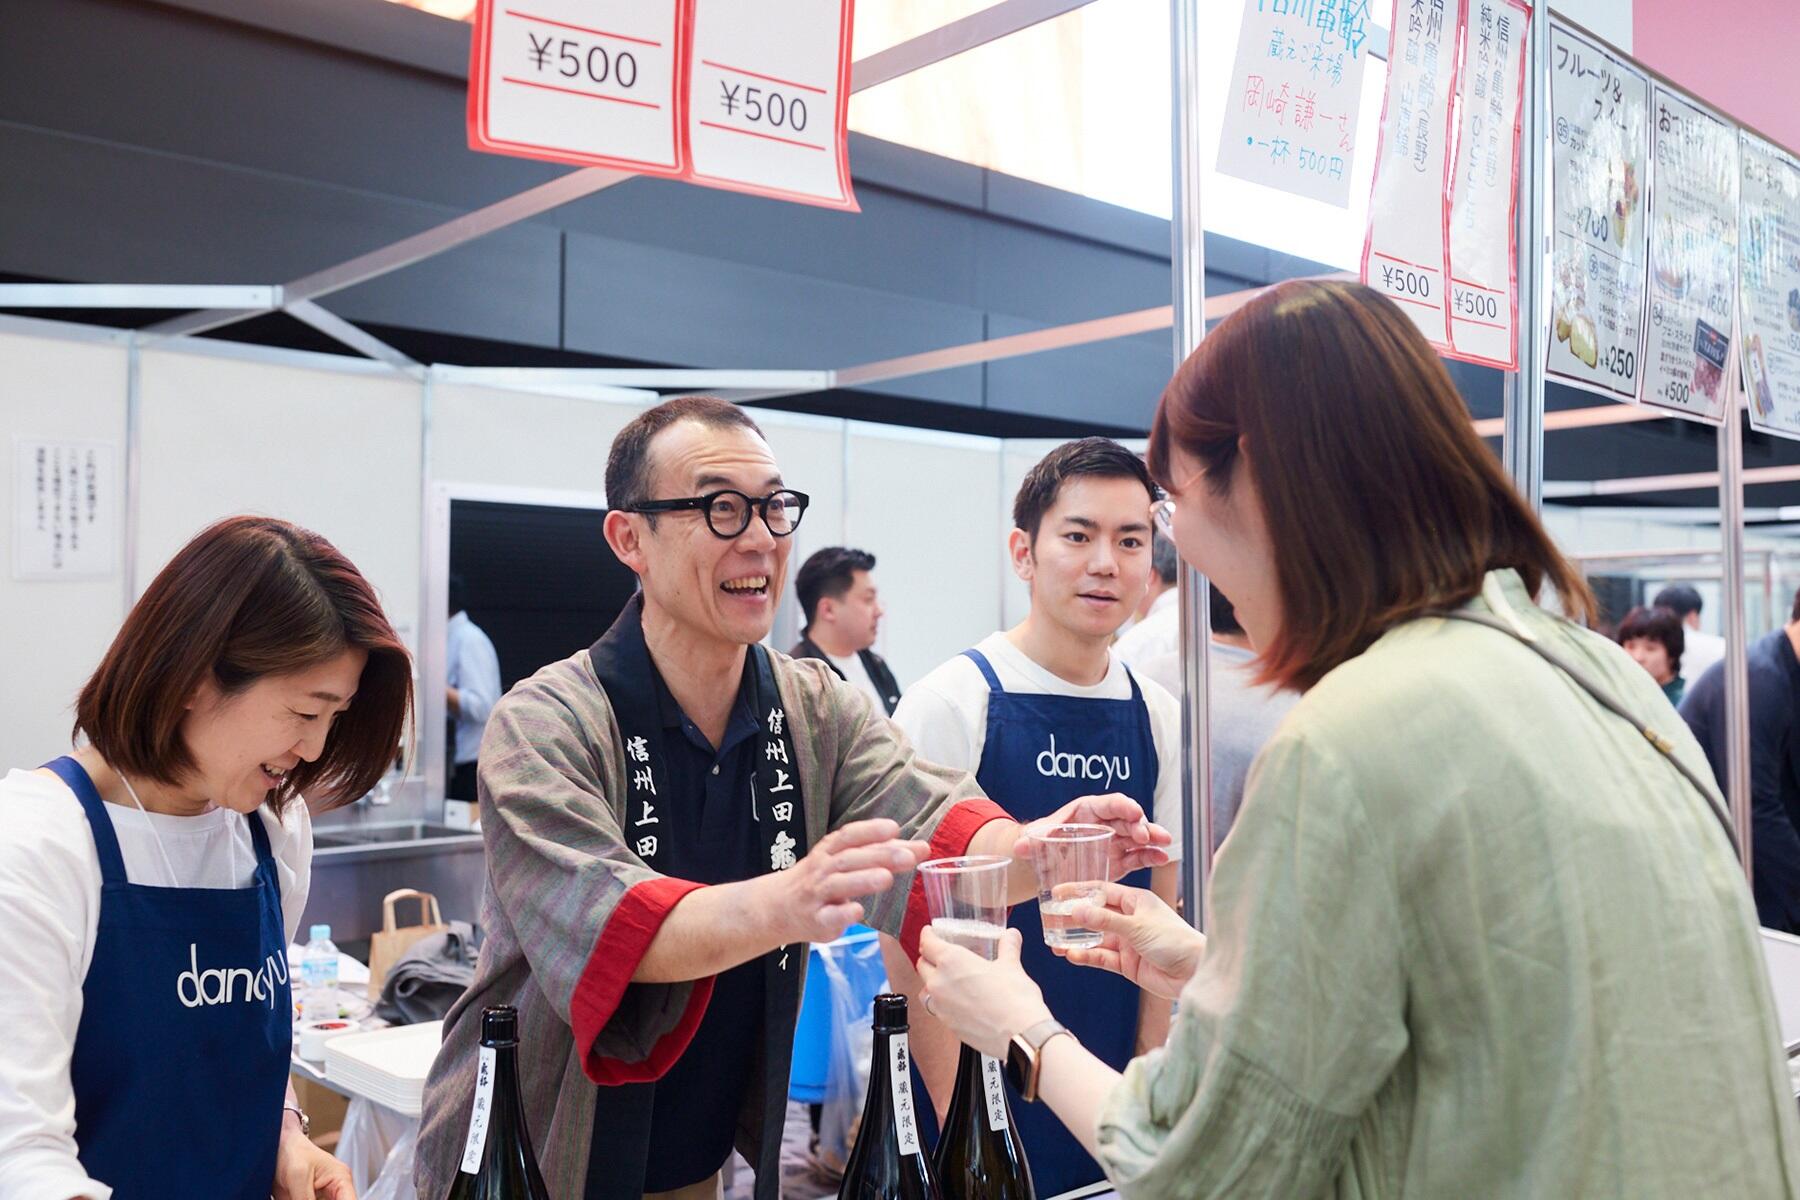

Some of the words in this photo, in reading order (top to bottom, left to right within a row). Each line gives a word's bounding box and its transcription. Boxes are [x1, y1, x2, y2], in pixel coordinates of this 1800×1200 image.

[528, 32, 638, 88] ¥500
[720, 80, 808, 131] ¥500
[1382, 264, 1430, 298] ¥500
[1454, 288, 1498, 319] ¥500
[1605, 345, 1635, 380] ¥250
[1665, 381, 1690, 404] ¥500
[1036, 732, 1131, 790] dancyu
[626, 735, 660, 858] 信州上田
[176, 943, 288, 1010] dancyu
[898, 1081, 915, 1146] 蔵元限定
[987, 1060, 1004, 1122] 蔵元限定
